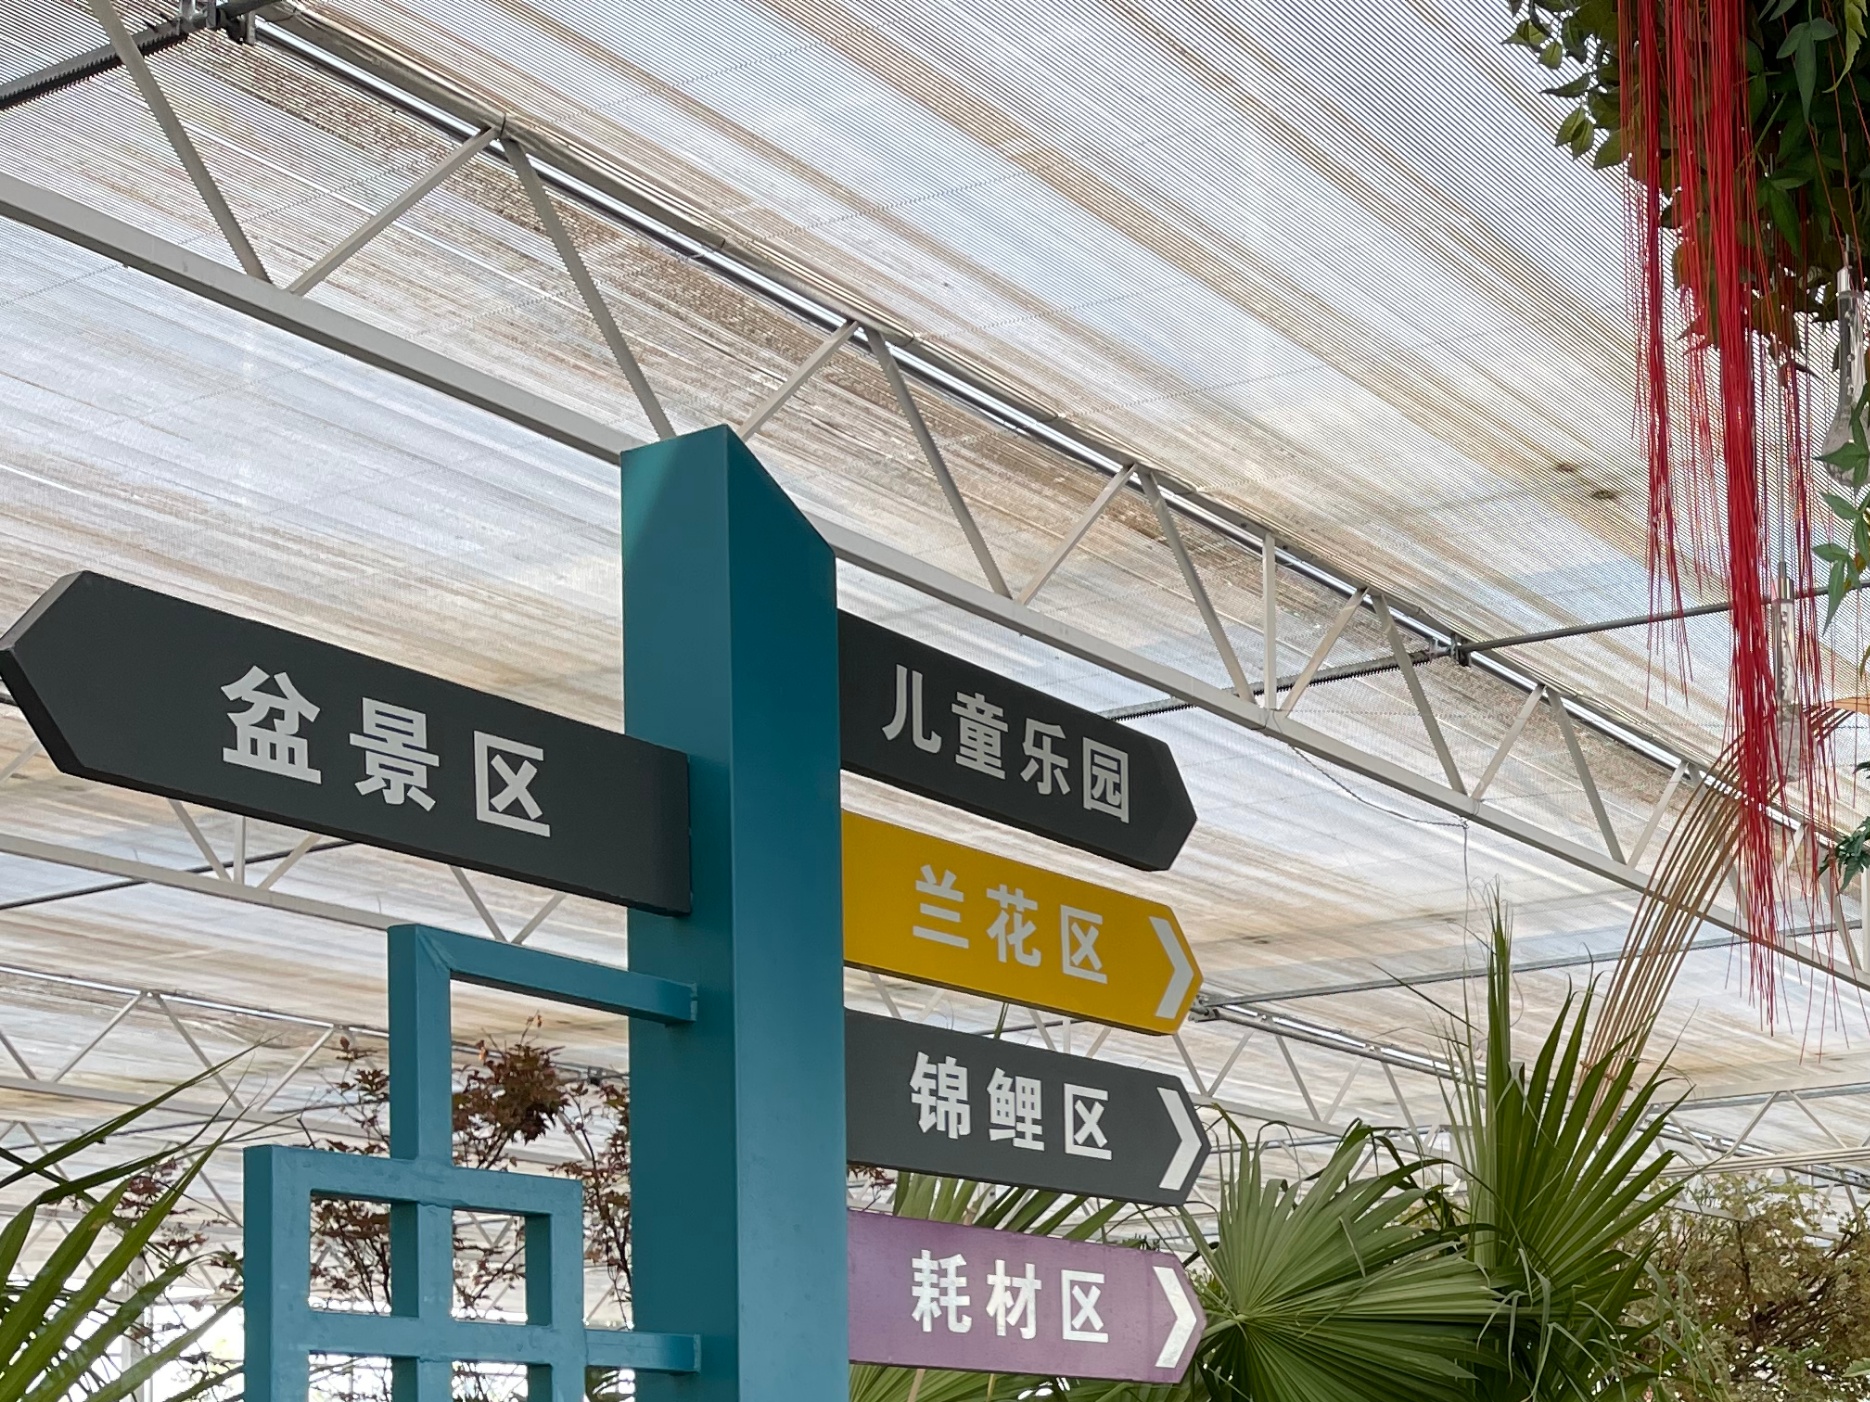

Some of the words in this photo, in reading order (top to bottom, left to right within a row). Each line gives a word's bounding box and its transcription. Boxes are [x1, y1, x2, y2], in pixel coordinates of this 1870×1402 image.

[222, 665, 551, 838] 盆景区
[882, 664, 1130, 824] 儿童乐园
[913, 865, 1108, 983] 兰花区
[909, 1052, 1113, 1161] 锦鲤区
[911, 1249, 1109, 1344] 耗材区
